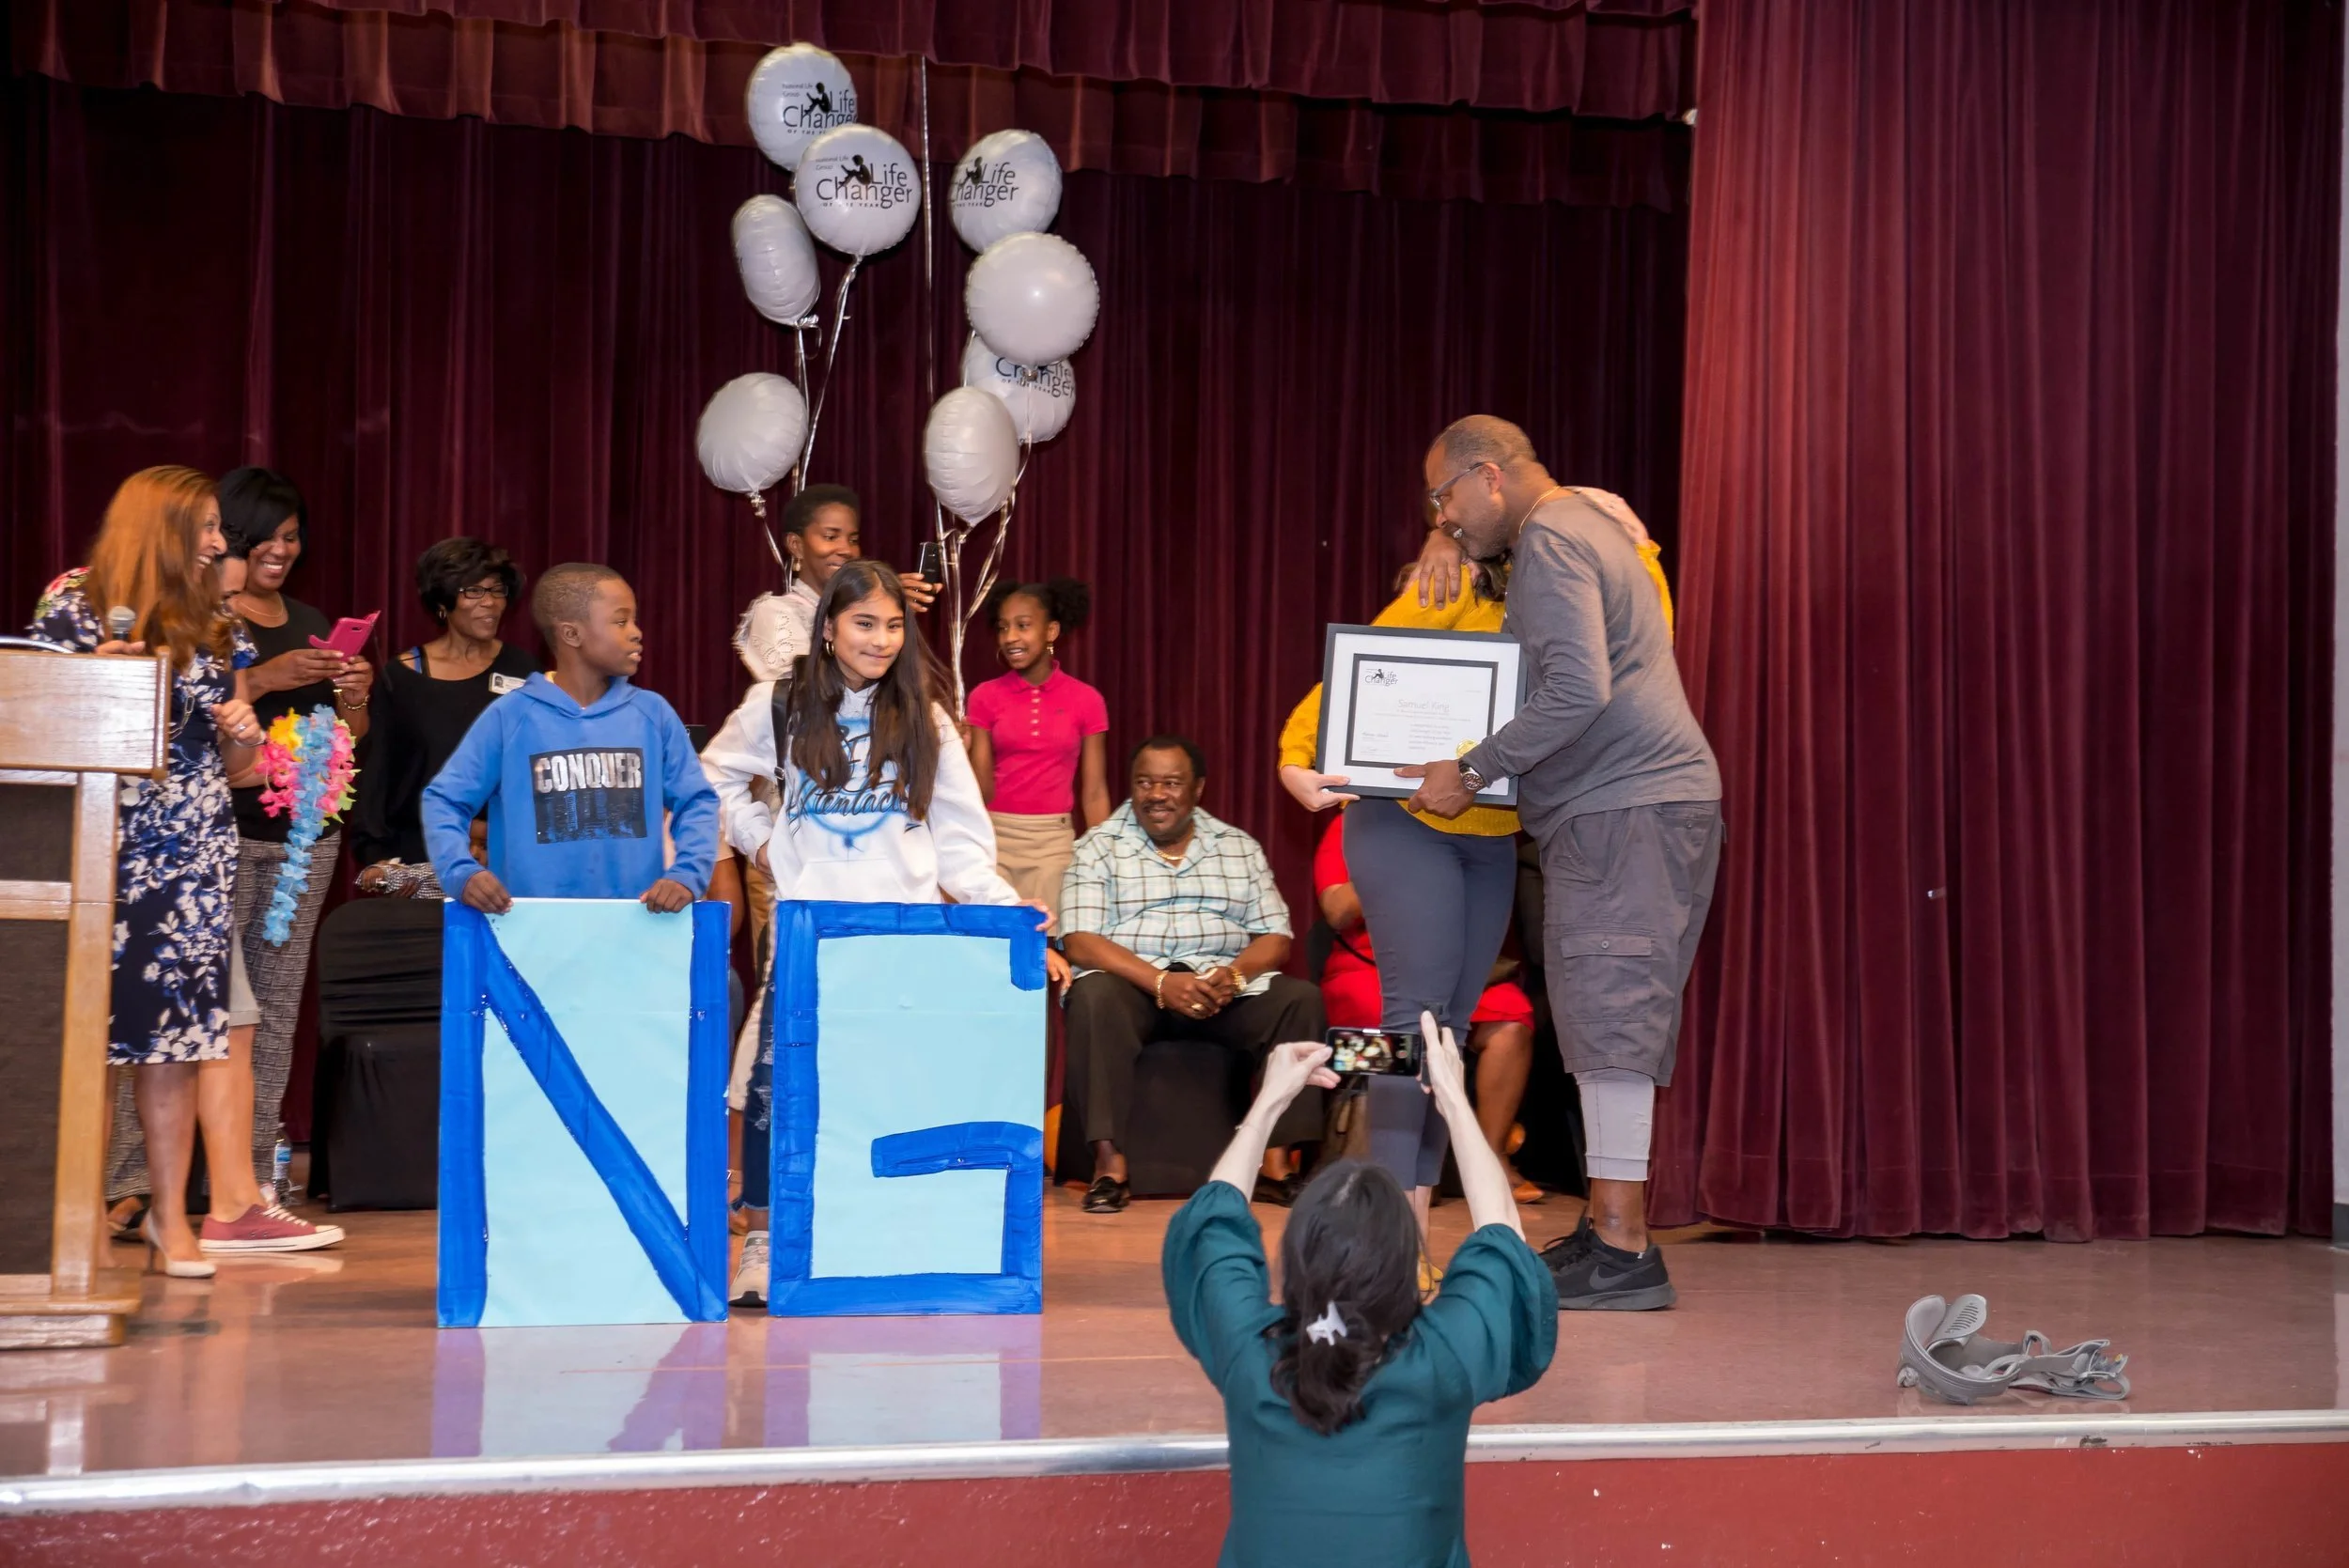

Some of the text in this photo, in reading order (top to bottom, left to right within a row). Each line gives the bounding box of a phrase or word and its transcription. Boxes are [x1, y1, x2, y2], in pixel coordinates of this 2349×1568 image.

[830, 89, 855, 113] Life
[870, 163, 908, 187] Life
[980, 162, 1016, 185] Life
[817, 176, 912, 209] Changer
[996, 357, 1075, 398] Chnger
[1364, 675, 1399, 687] Changer
[1384, 671, 1397, 679] Life
[1398, 699, 1429, 710] Samuel
[1432, 701, 1450, 713] King
[535, 753, 642, 794] CONQUER
[438, 899, 730, 1328] N
[769, 899, 1047, 1318] G
